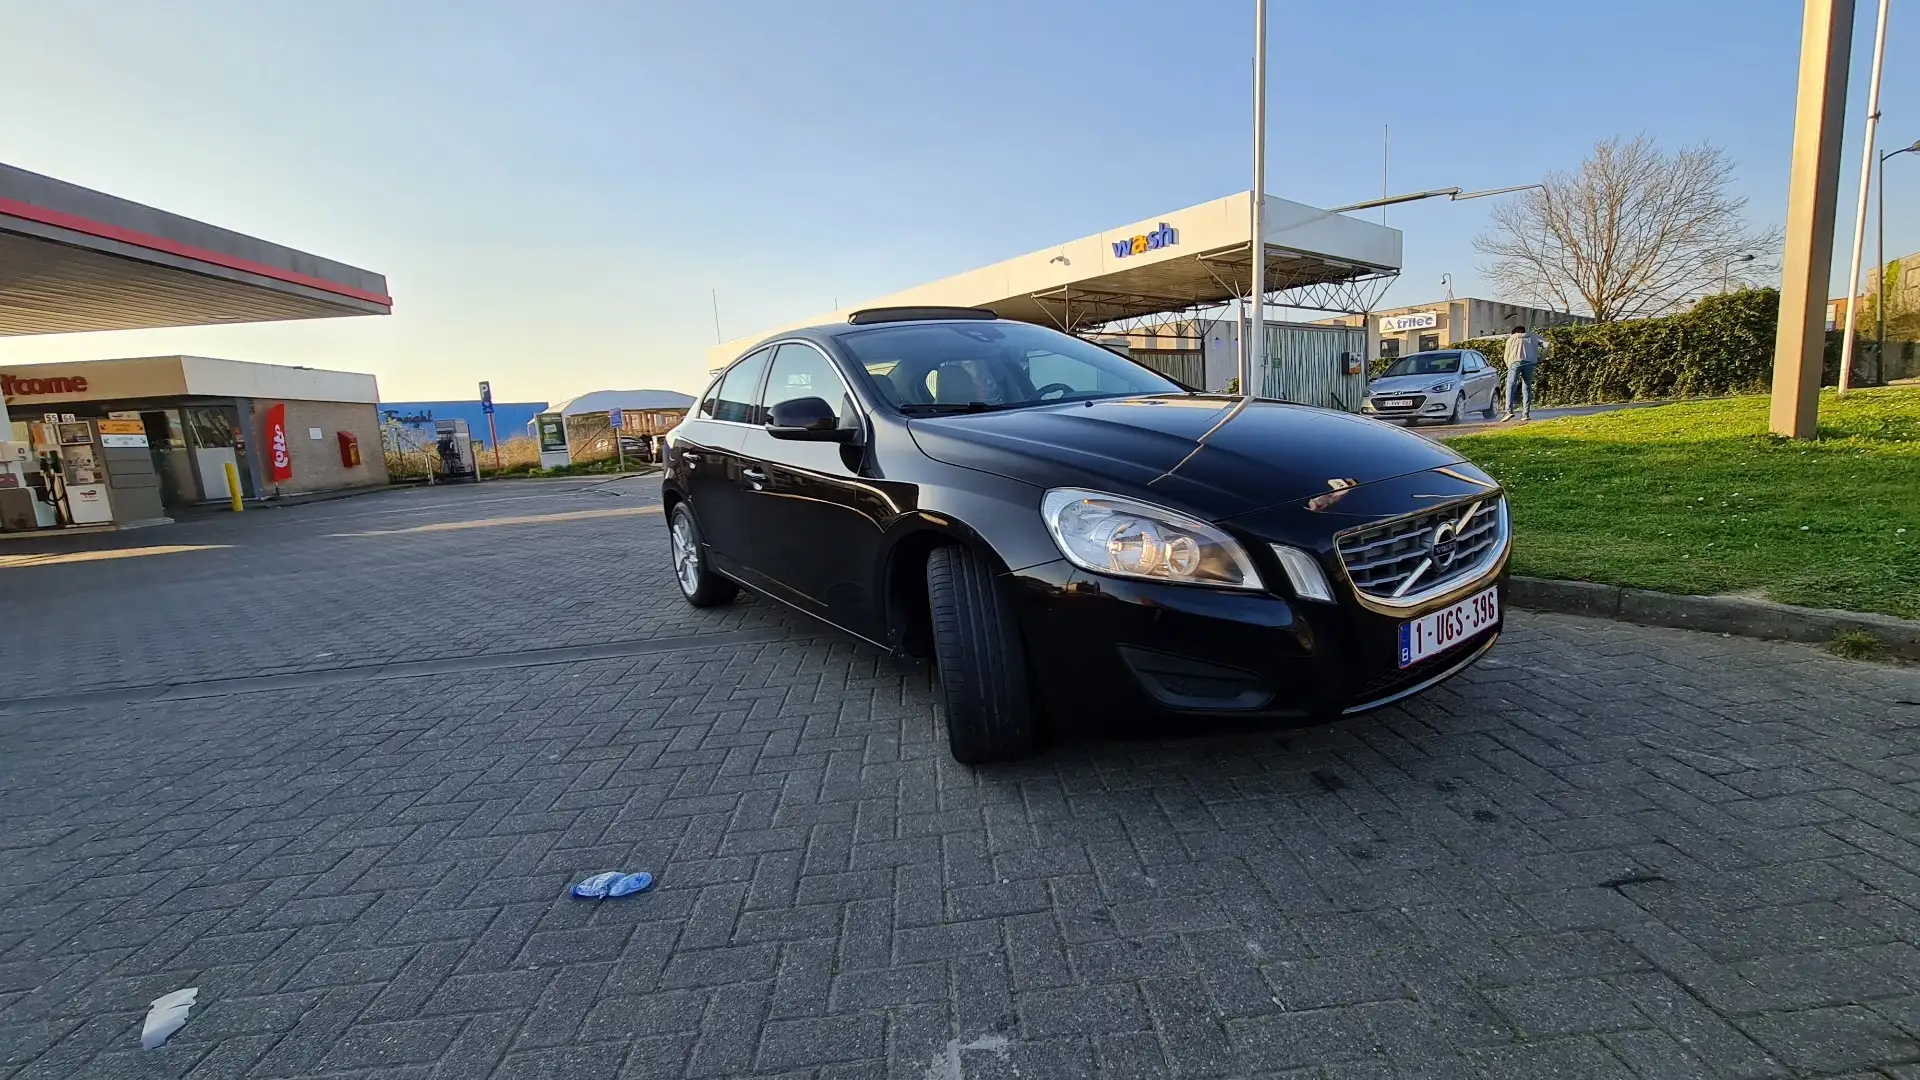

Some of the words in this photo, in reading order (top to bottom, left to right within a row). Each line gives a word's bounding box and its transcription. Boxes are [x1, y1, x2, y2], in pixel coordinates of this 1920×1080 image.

[1112, 222, 1179, 258] wash
[1397, 317, 1433, 329] trilec
[481, 384, 488, 397] P
[1416, 591, 1495, 655] 1-UGS-396
[1402, 647, 1409, 662] B
